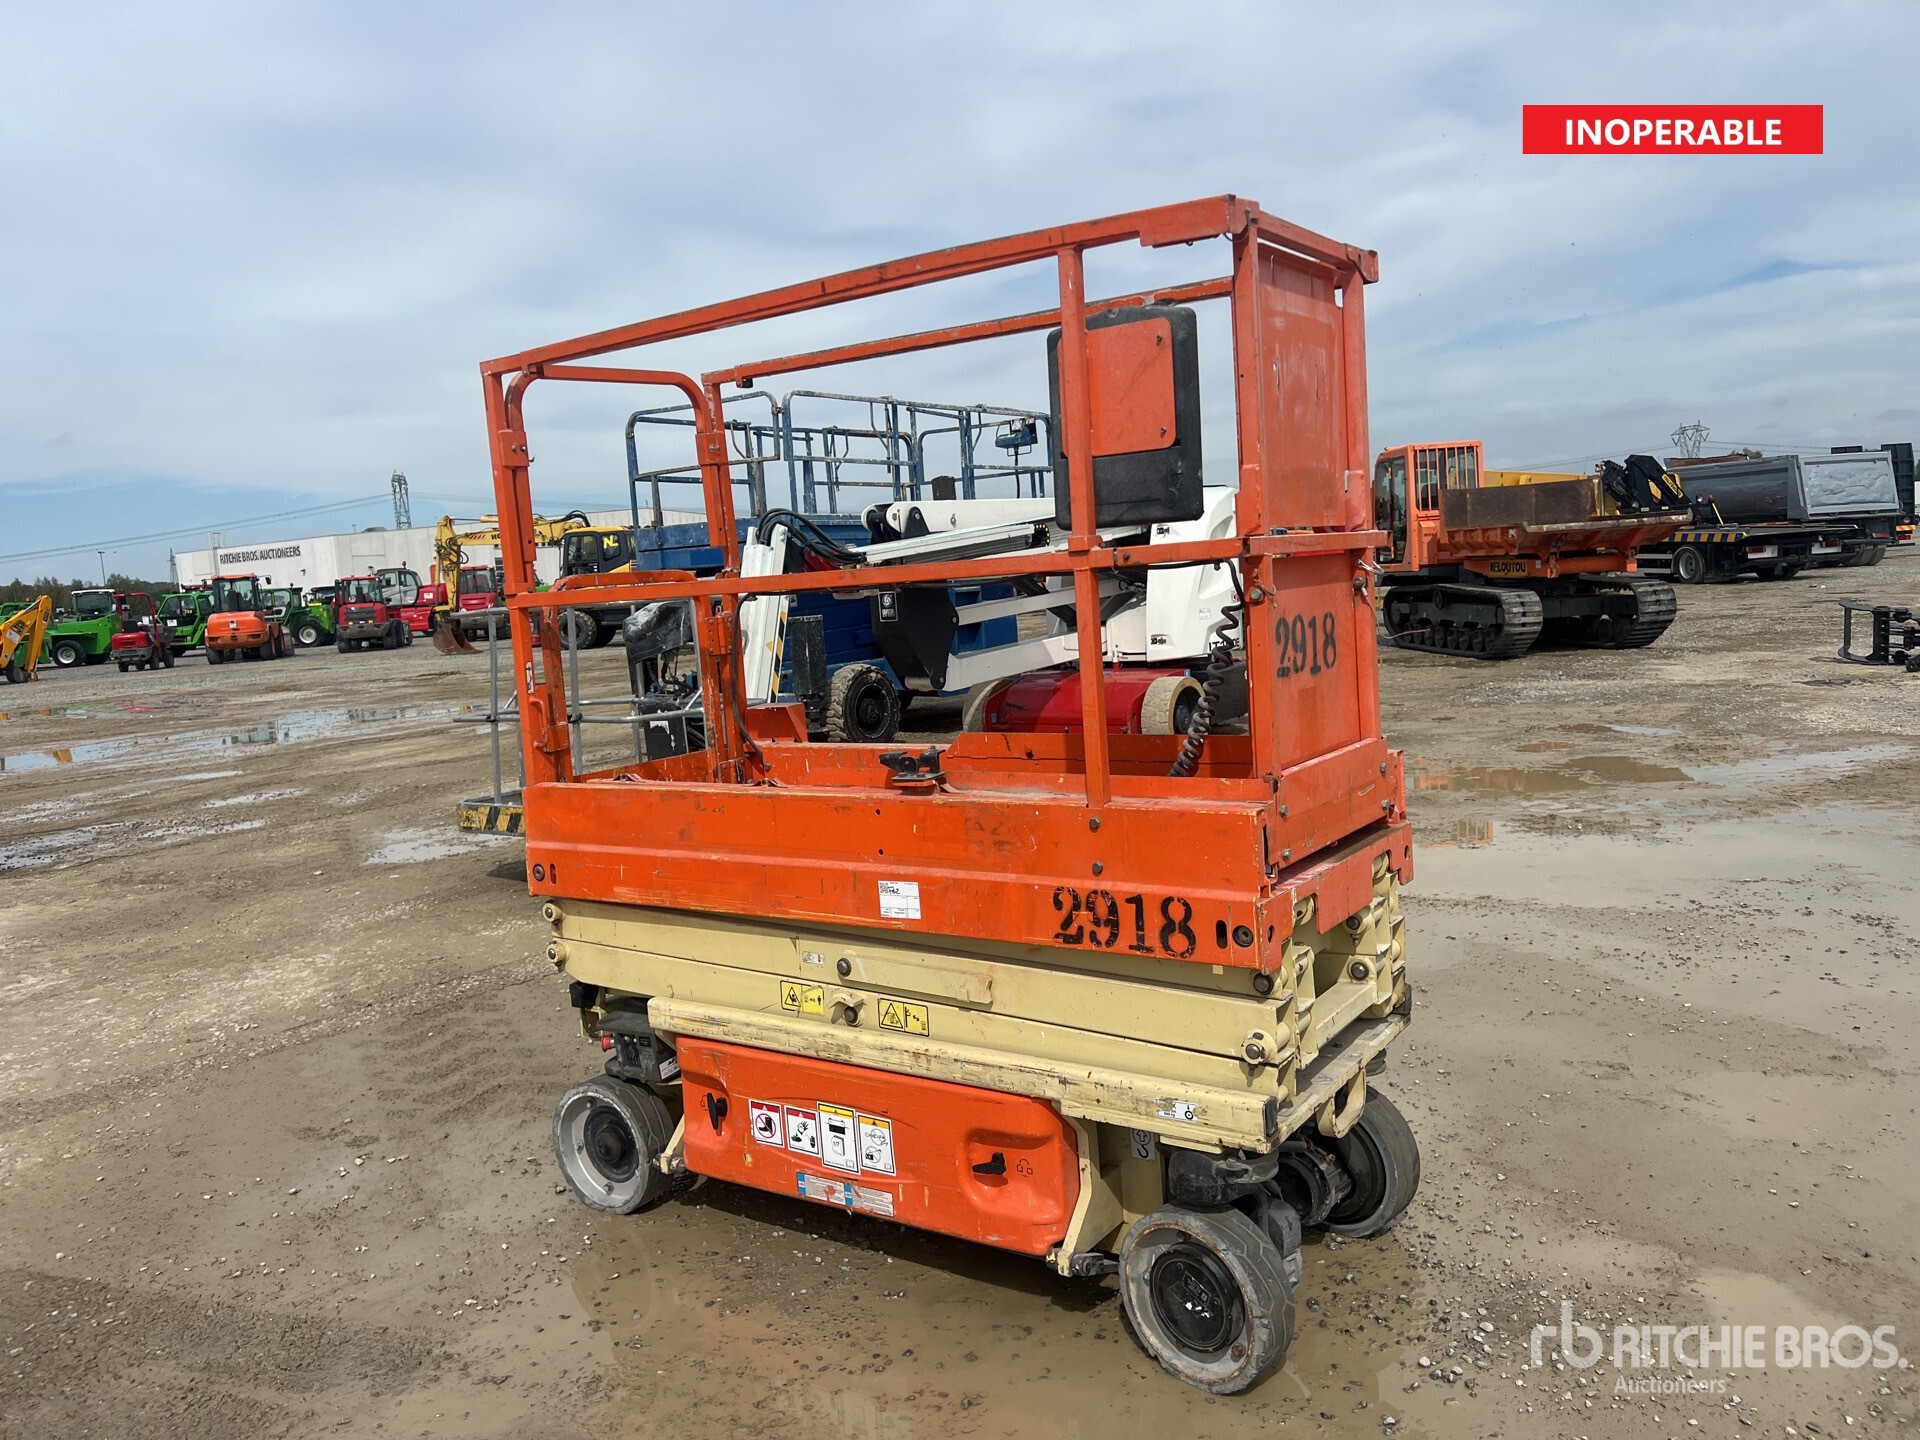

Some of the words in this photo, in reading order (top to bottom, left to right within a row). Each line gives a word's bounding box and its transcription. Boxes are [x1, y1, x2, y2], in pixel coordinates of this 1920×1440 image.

[220, 553, 242, 564] RITCHIE
[242, 550, 260, 562] BROS.
[260, 545, 301, 560] AUCTIONEERS
[1275, 611, 1337, 678] 2918
[1052, 886, 1197, 959] 2918
